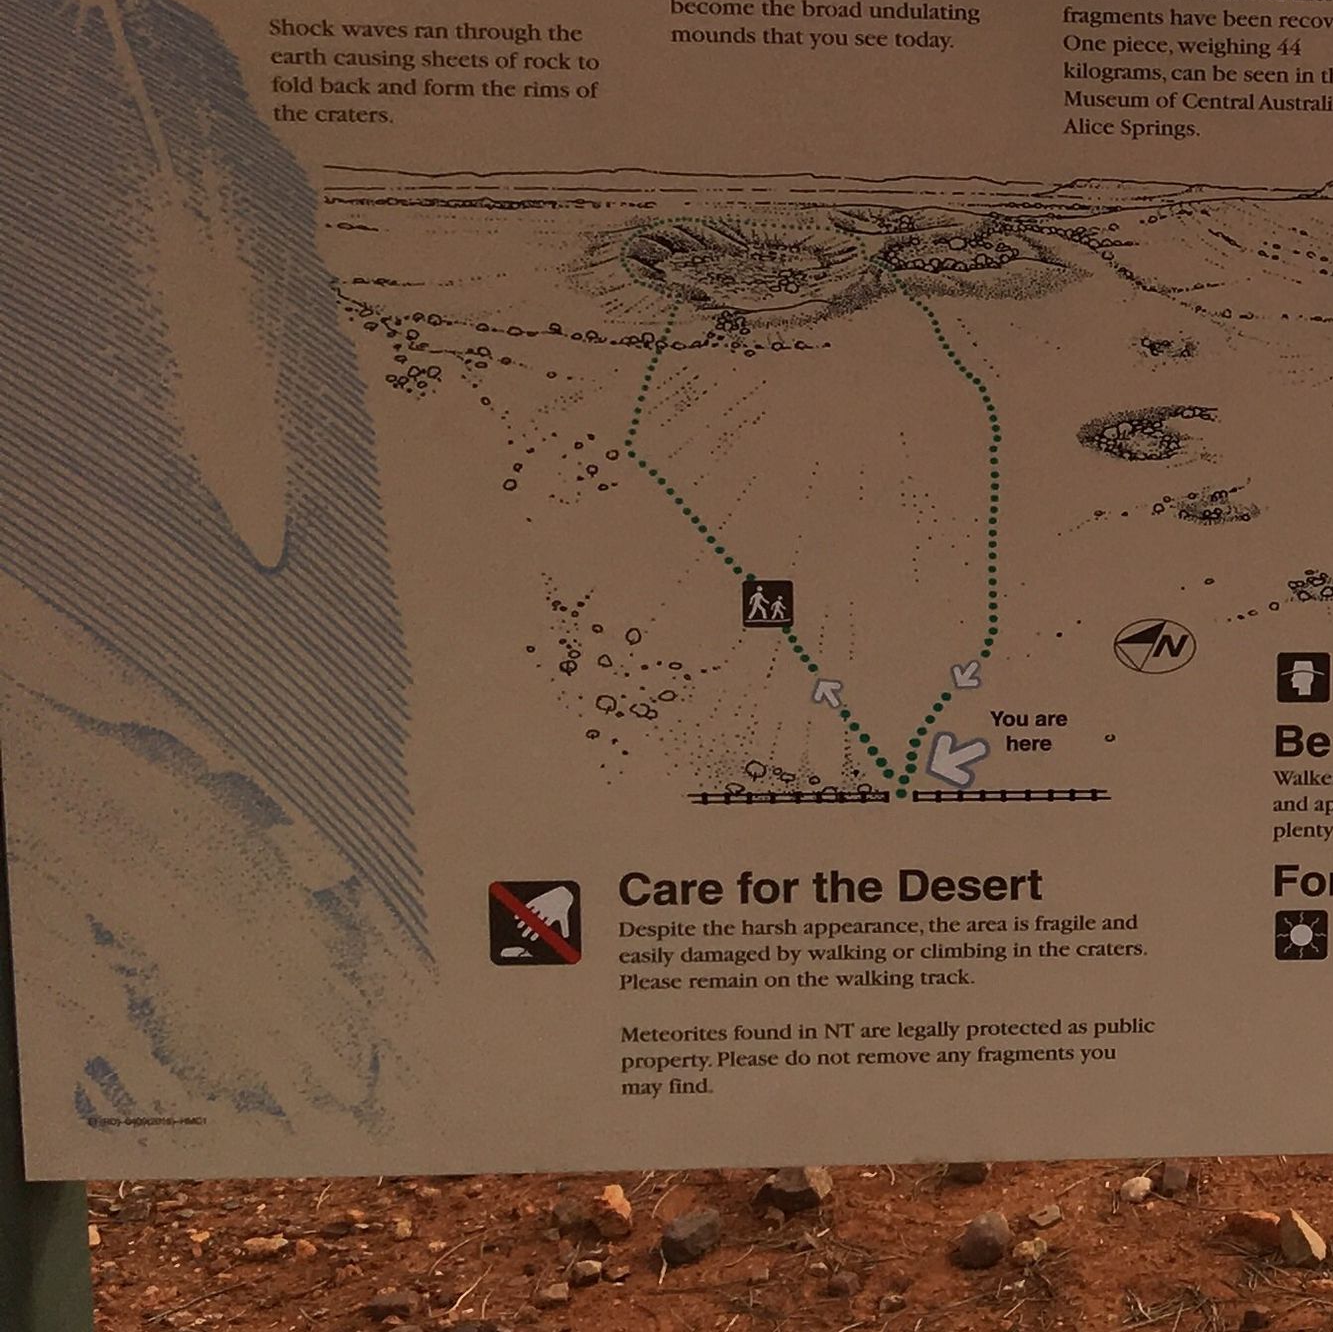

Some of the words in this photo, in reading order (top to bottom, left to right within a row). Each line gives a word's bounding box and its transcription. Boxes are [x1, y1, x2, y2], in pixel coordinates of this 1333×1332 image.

[1063, 117, 1115, 135] Alice
[1120, 119, 1200, 141] Springs.
[1152, 634, 1189, 658] N
[990, 710, 1029, 727] You
[1035, 713, 1068, 727] are
[1006, 735, 1052, 752] here
[1275, 724, 1331, 758] Be
[619, 871, 724, 907] Care
[736, 870, 800, 905] for
[812, 870, 883, 904] the
[899, 869, 1043, 902] Desert
[620, 973, 682, 991] Please
[689, 972, 758, 989] remain
[764, 975, 790, 988] on
[797, 970, 829, 988] the
[835, 969, 915, 990] walking
[920, 968, 975, 985] track.
